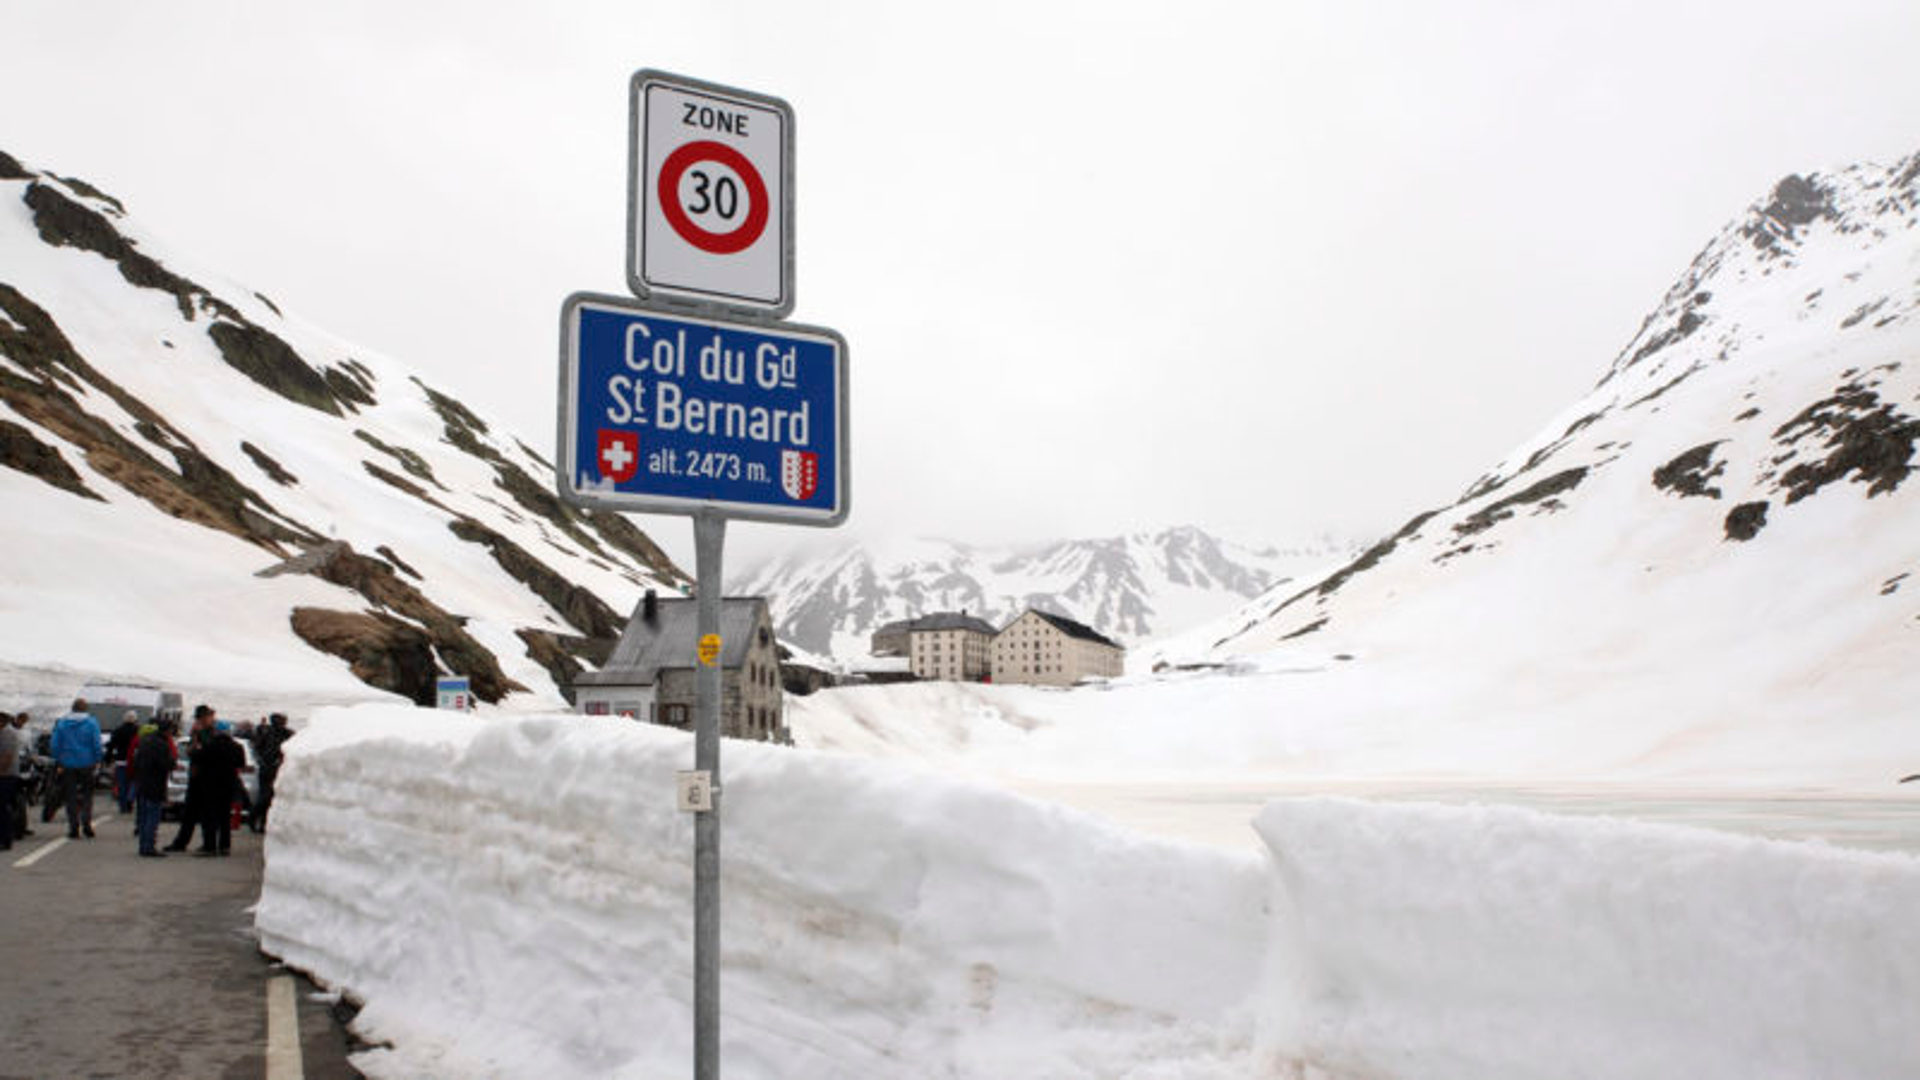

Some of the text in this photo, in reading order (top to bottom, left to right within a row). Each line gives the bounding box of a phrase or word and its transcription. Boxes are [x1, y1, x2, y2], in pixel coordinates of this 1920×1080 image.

[682, 102, 750, 137] ZONE
[688, 170, 738, 219] 30
[625, 322, 797, 390] Col du Gd
[606, 375, 810, 446] St Bernard
[648, 448, 771, 484] alt. 2473 m.
